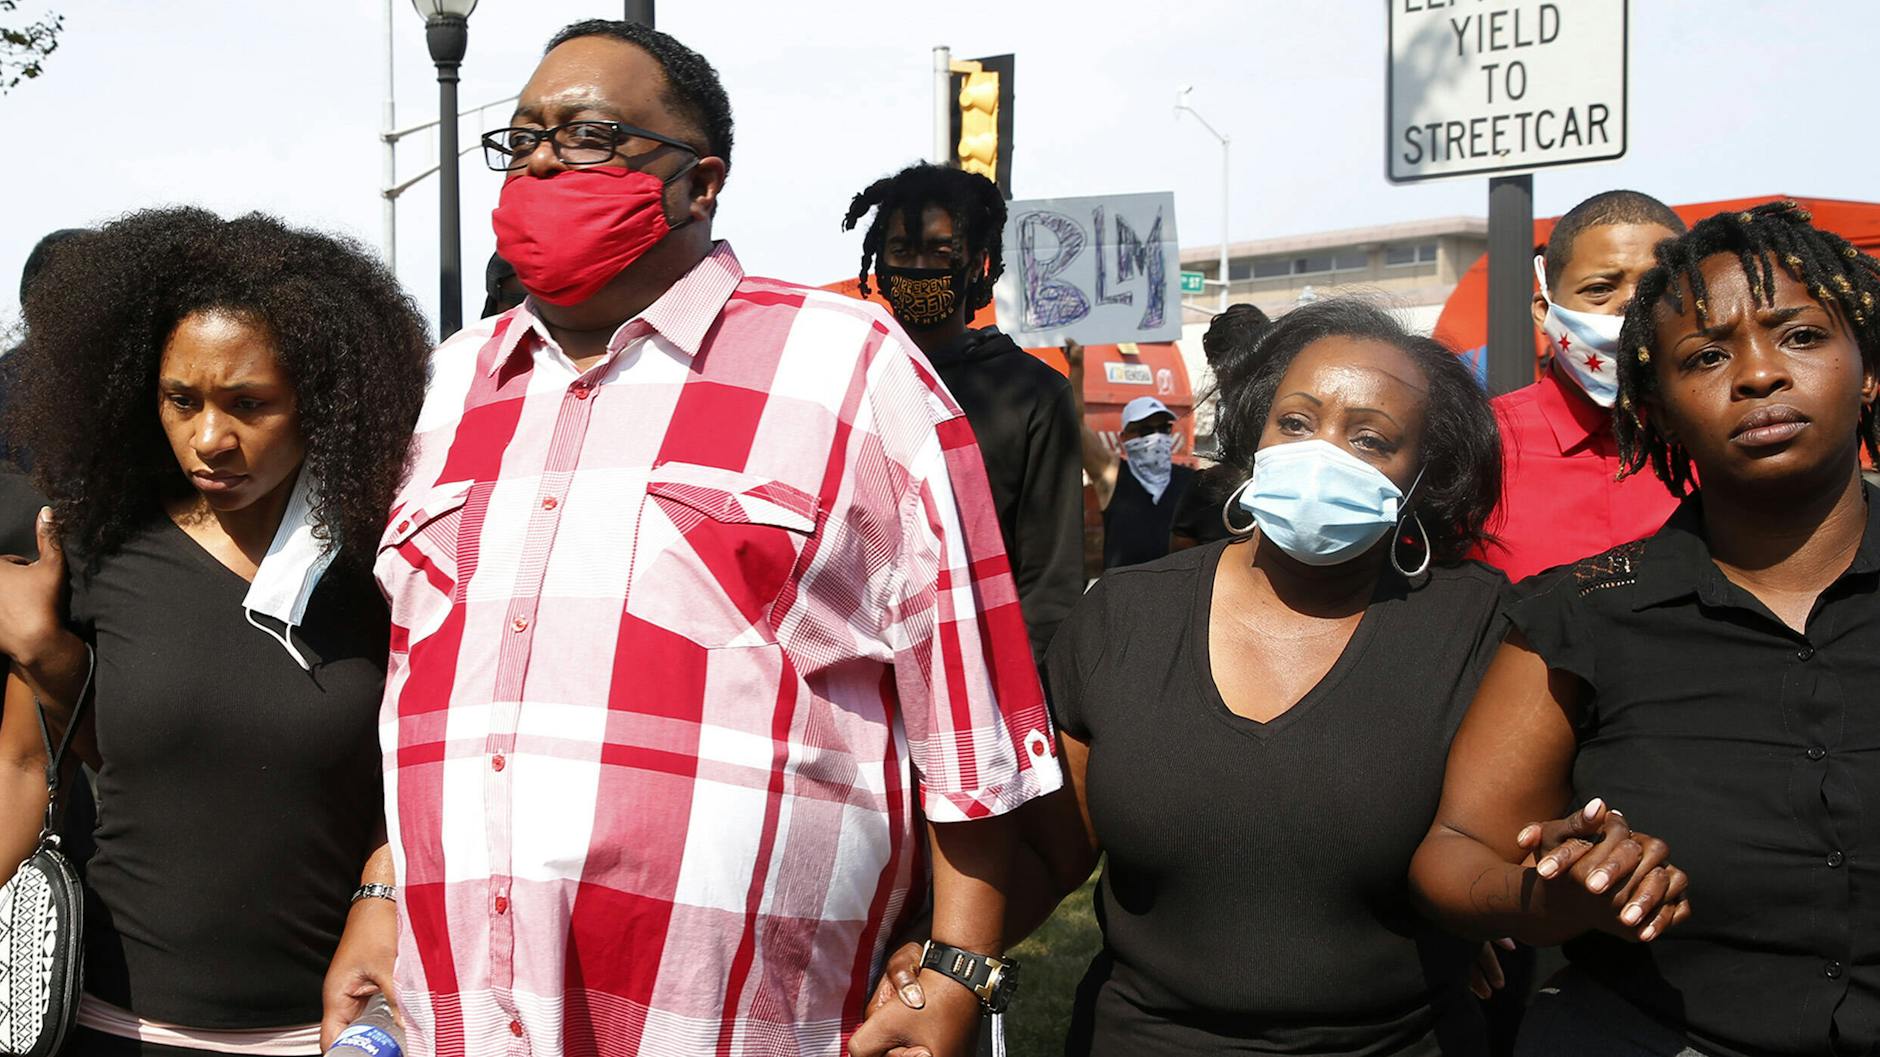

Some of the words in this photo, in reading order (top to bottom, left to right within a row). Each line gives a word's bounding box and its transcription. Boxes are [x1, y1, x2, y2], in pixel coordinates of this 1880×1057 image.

[1451, 4, 1560, 56] YIELD
[1480, 61, 1526, 104] TO
[1404, 103, 1609, 165] STREETCAR
[1015, 204, 1167, 333] BLM
[894, 305, 954, 324] OTHING
